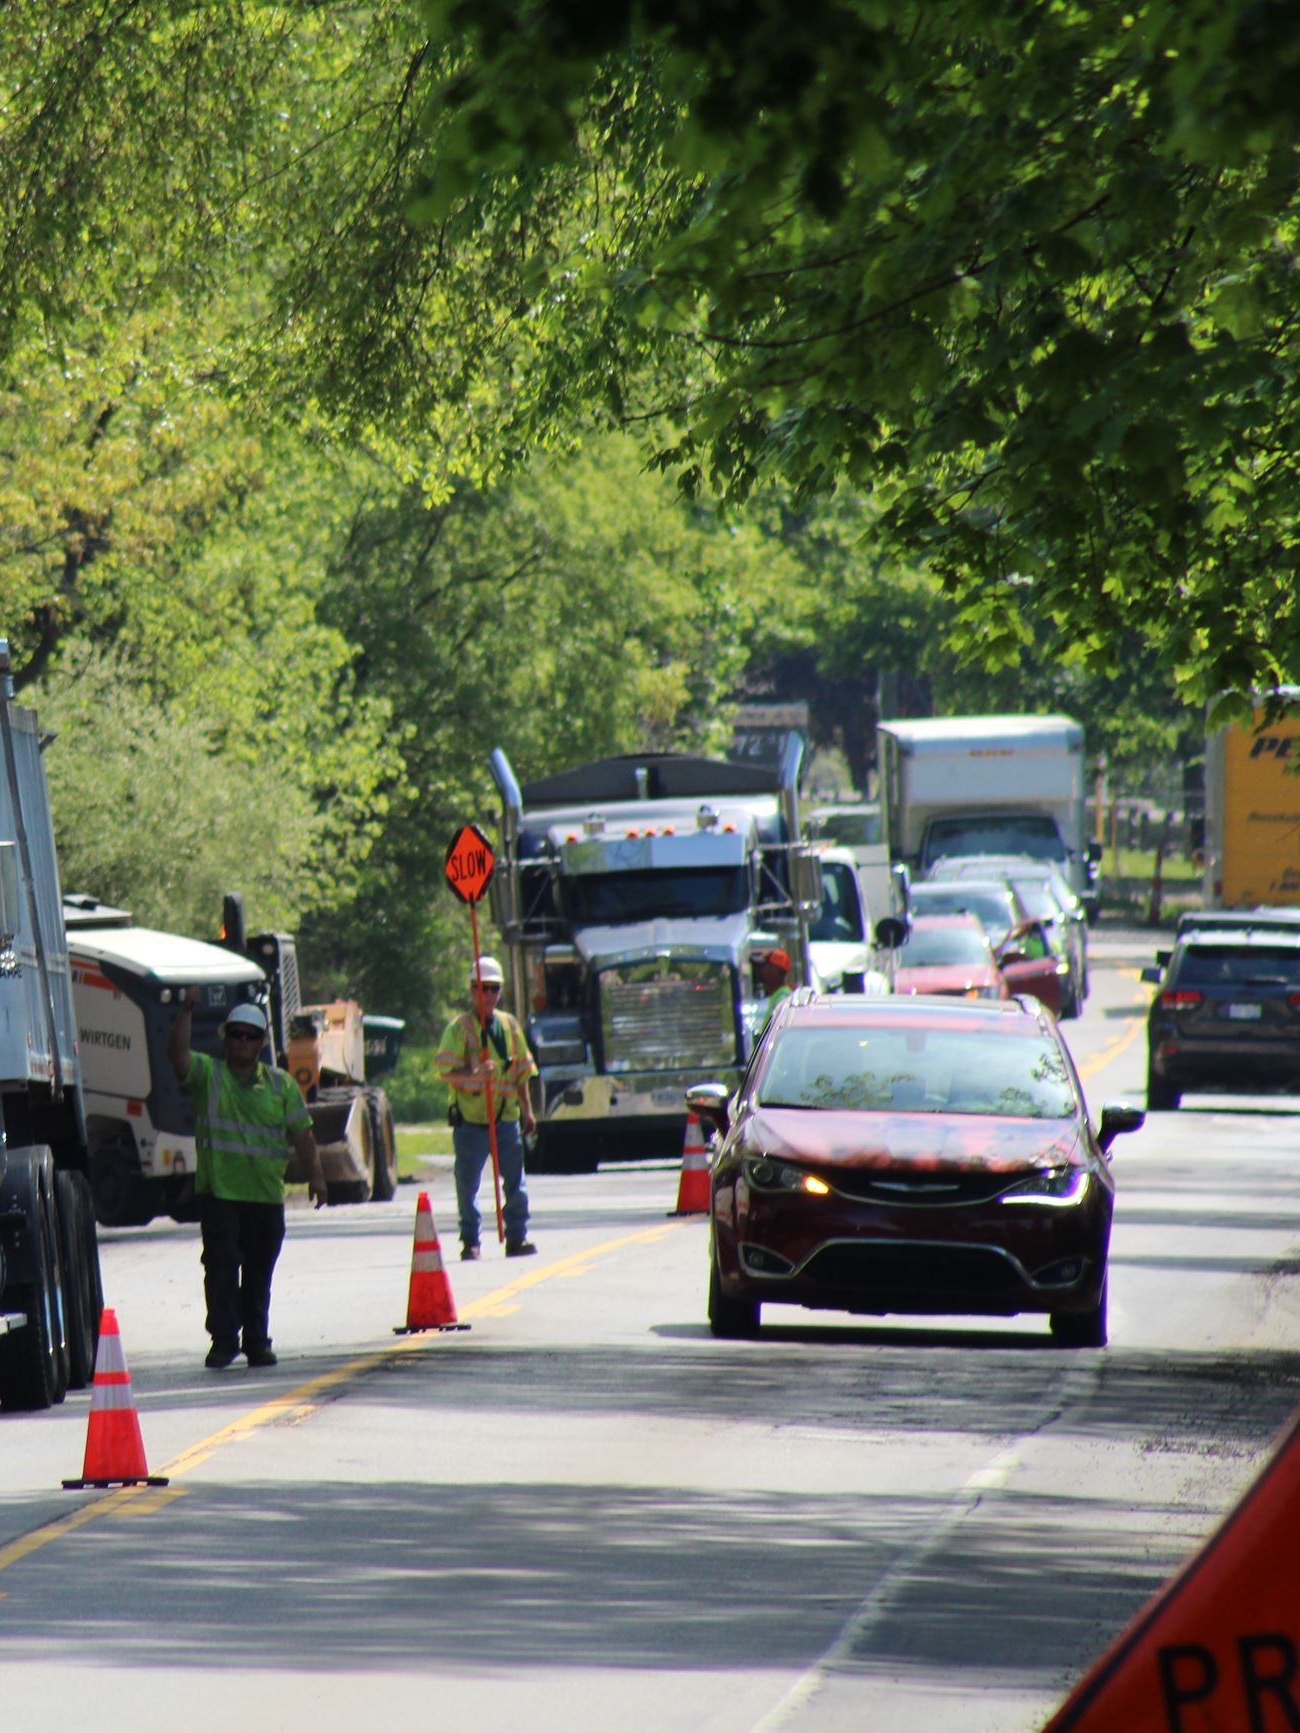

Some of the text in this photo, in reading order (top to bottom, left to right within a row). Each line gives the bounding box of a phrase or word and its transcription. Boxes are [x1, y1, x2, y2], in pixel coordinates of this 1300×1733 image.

[451, 848, 486, 881] SLOW
[79, 1028, 131, 1051] WIRTGEN
[1157, 1633, 1300, 1733] PR
